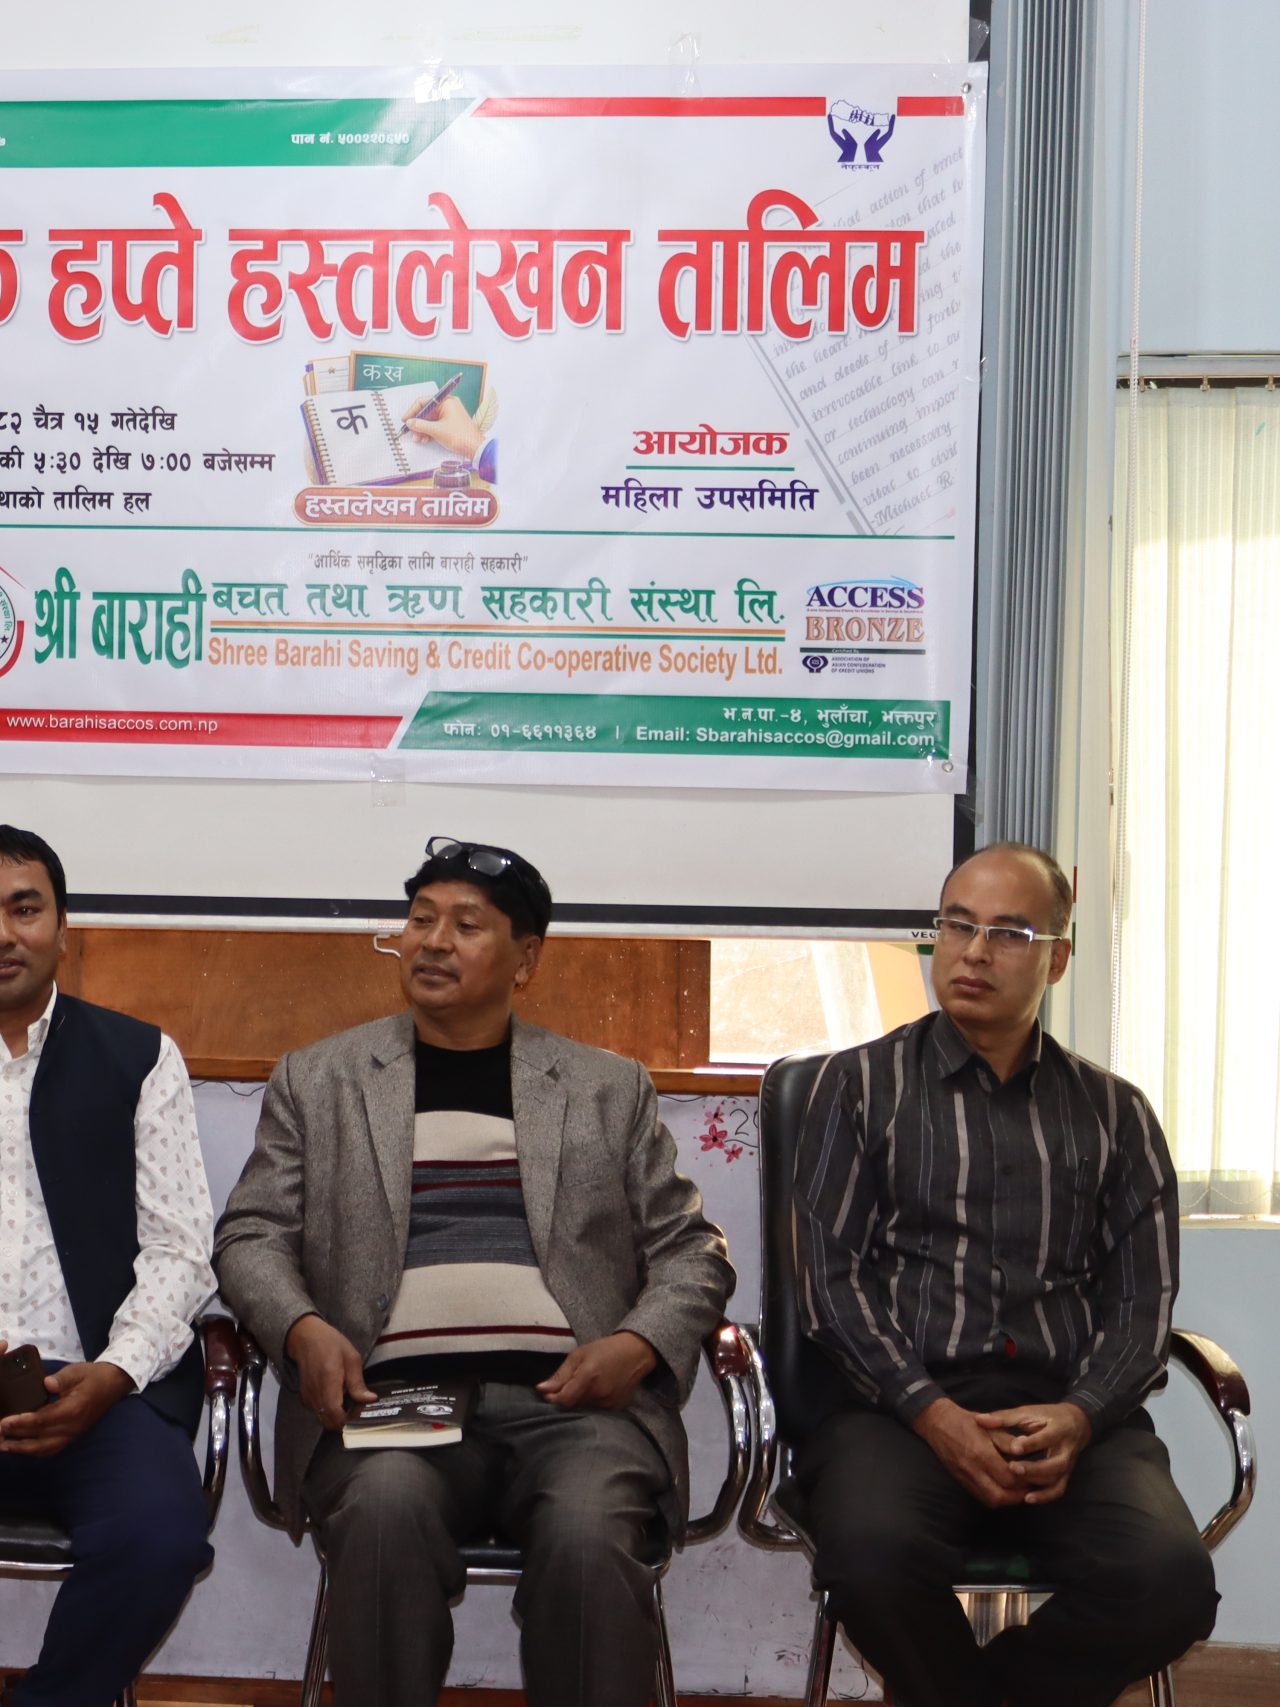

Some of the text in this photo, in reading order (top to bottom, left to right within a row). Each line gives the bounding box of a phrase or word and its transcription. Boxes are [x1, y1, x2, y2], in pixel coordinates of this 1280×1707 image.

[291, 134, 315, 144] पान
[48, 191, 204, 342] हप्ते
[228, 190, 633, 342] हस्तलेखन
[657, 187, 926, 341] तालिम
[32, 404, 65, 431] चैत्र
[74, 411, 99, 434] १५
[110, 405, 178, 434] गतेदेखि
[330, 404, 369, 435] क
[632, 423, 791, 456] आयोजक
[33, 451, 81, 474] ५:३०
[92, 445, 132, 474] देखि
[141, 452, 191, 472] ७:००
[202, 447, 277, 474] बजेसम्म
[52, 484, 115, 512] तालिम
[122, 491, 152, 514] हल
[304, 491, 492, 518] हस्तलेखन तालिम
[600, 477, 820, 514] महिला उपसमिति
[408, 551, 435, 571] लागि
[440, 552, 475, 573] बाराही
[211, 576, 785, 625] बचत तथा ऋण सहकारी संस्था लि.
[806, 585, 925, 609] ACCESS
[34, 566, 207, 669] श्री बाराही
[805, 616, 925, 642] BRONZE
[208, 636, 784, 682] Shree Barahi Saving & Credit Co-operative Society Ltd.
[6, 714, 218, 733] www.barahisaccos.com.np
[490, 723, 597, 741] ०१-६६११३६४
[881, 710, 938, 729] भक्तपुर
[636, 726, 690, 741] Email:
[696, 727, 935, 748] Sbarahisaccos@gmail.com
